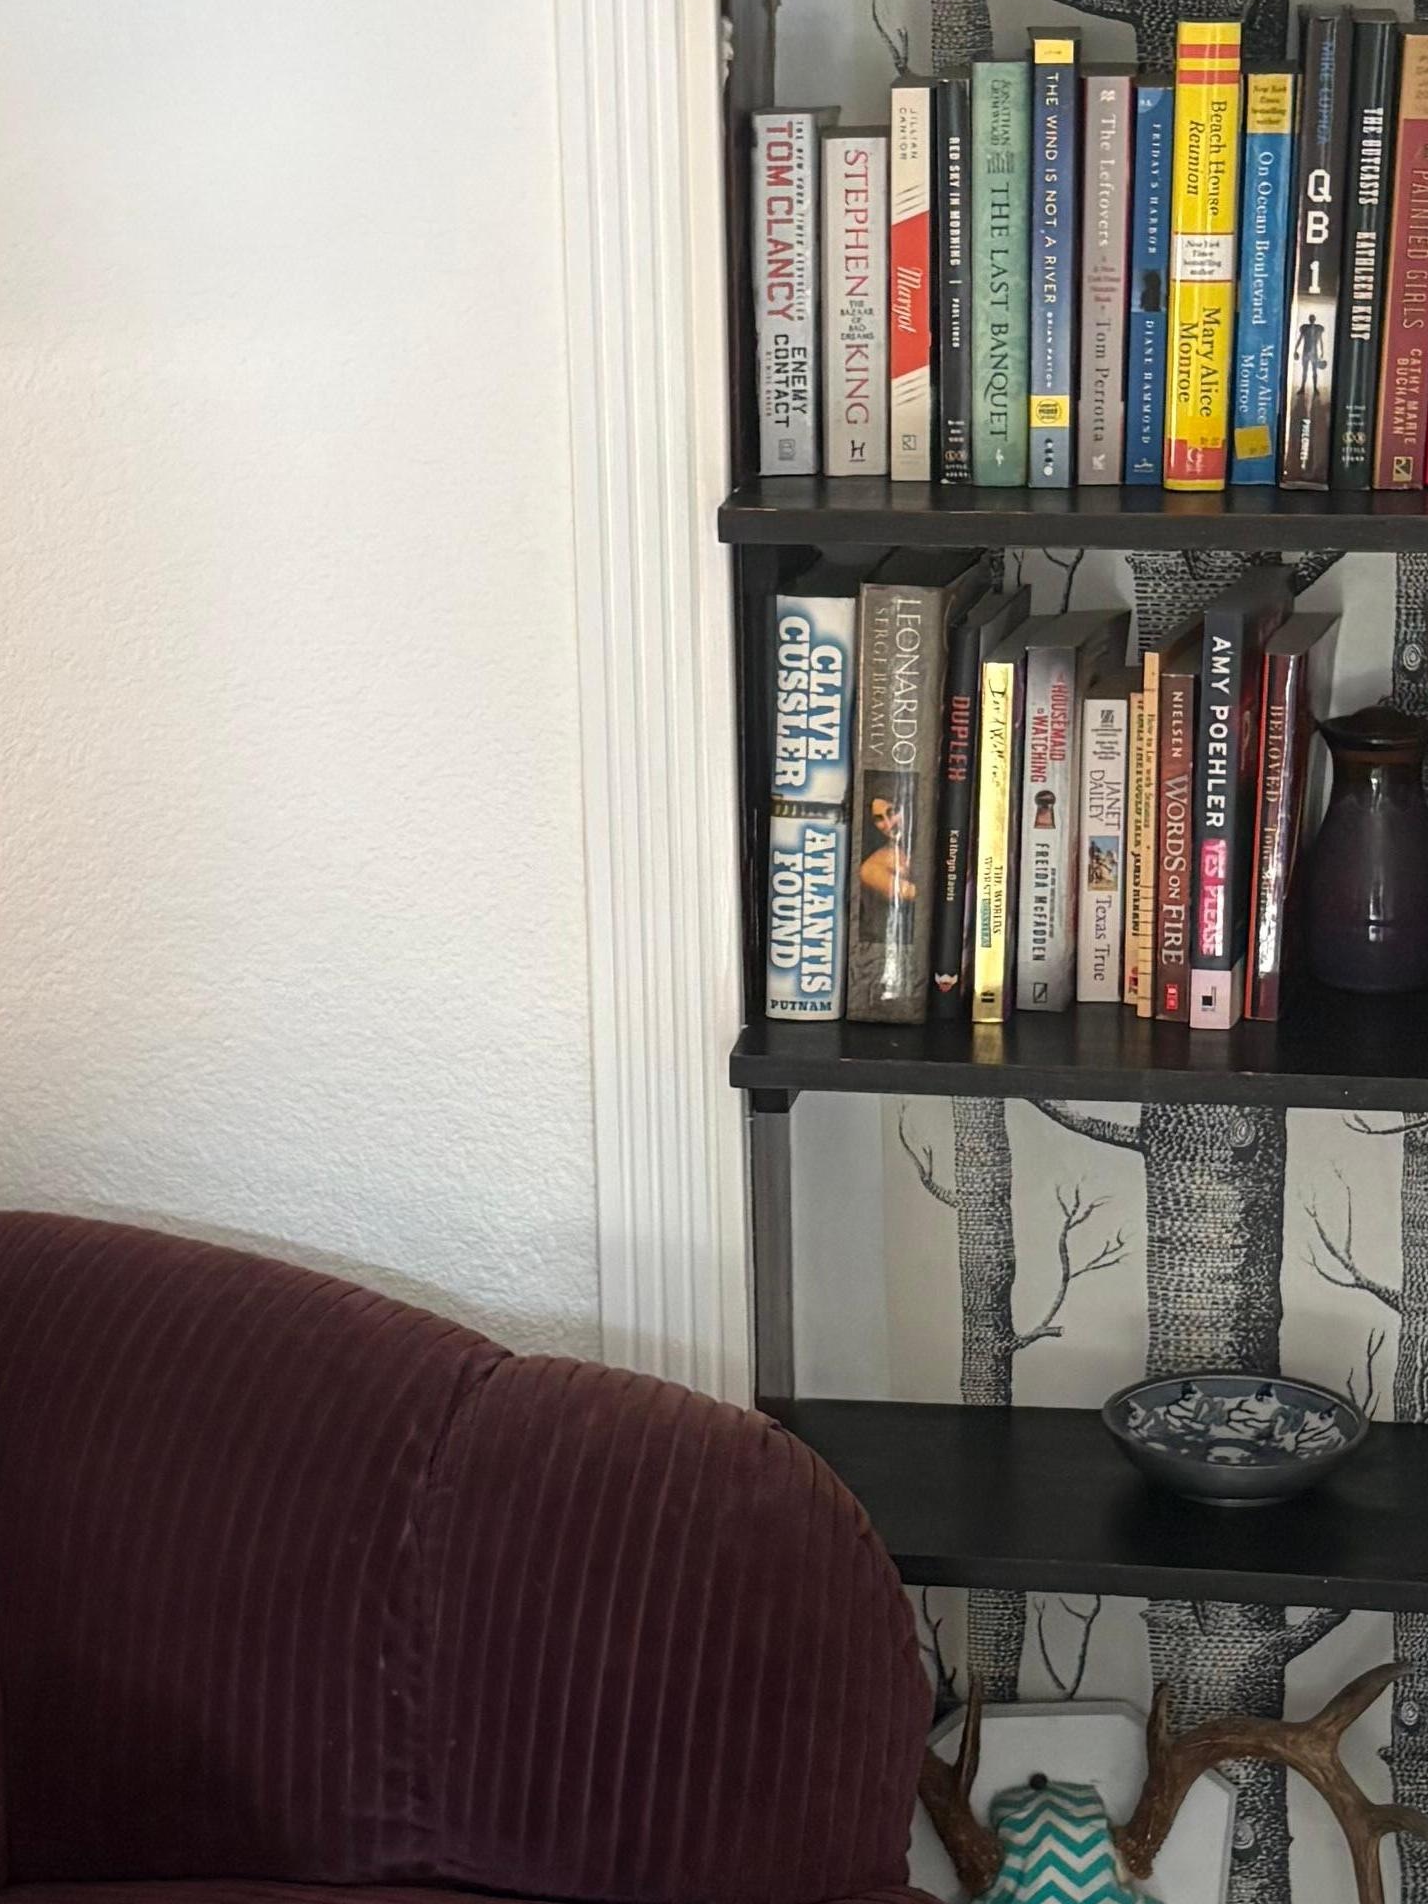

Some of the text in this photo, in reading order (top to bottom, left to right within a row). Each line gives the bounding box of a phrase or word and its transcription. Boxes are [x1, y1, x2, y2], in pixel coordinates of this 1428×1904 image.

[1100, 114, 1117, 151] The
[1186, 119, 1205, 196] Reunion
[1209, 100, 1228, 156] Beach
[1358, 107, 1385, 206] THE OUTCASTS
[766, 120, 795, 322] TOM CLANCY
[843, 148, 870, 297] STEPHEN
[948, 136, 961, 267] RED SKY IN MORNING
[990, 182, 1011, 239] THE
[1043, 72, 1060, 304] THE WIND IS NOT A RIVER
[1098, 160, 1116, 247] Leftovers
[1251, 151, 1275, 326] On Ocean Boulevard
[989, 248, 1010, 311] LAST
[1350, 231, 1377, 341] KATHLEEN KENT
[1401, 268, 1428, 330] GIRLS
[1093, 320, 1112, 360] Tom
[1143, 319, 1155, 364] DIANE
[1177, 322, 1199, 404] Monroe
[1195, 307, 1222, 361] Mary
[773, 334, 790, 428] CONTACT
[791, 346, 808, 415] ENEMY
[844, 343, 870, 425] KING
[984, 322, 1009, 442] BANQUET
[1092, 367, 1110, 443] Perrotta
[1199, 365, 1219, 418] Alice
[1238, 354, 1256, 414] Monroe
[1256, 345, 1275, 425] Mary Alice
[1391, 357, 1409, 436] BUCHANAN
[1404, 348, 1423, 445] CATHY MARIE
[774, 615, 811, 788] CUSSLER
[807, 645, 843, 761] CLIVE
[891, 598, 923, 765] LEONARDO
[1030, 714, 1049, 784] WATCHING
[1048, 683, 1070, 762] HOUSEMAID
[1171, 690, 1184, 759] NIELSEN
[1205, 635, 1232, 828] AMY POEHLER
[1088, 769, 1105, 823] DAILEY
[1103, 780, 1122, 831] JANET
[946, 829, 961, 876] Kathryn
[1160, 774, 1191, 965] WORDS ON FIRE
[770, 850, 804, 969] FOUND
[800, 828, 837, 994] ATLANTIS
[1031, 842, 1051, 962] FREIDA McFADDEN
[1093, 894, 1113, 982] Texas True
[1200, 883, 1225, 957] PLEASE
[770, 999, 833, 1012] PUTNAM
